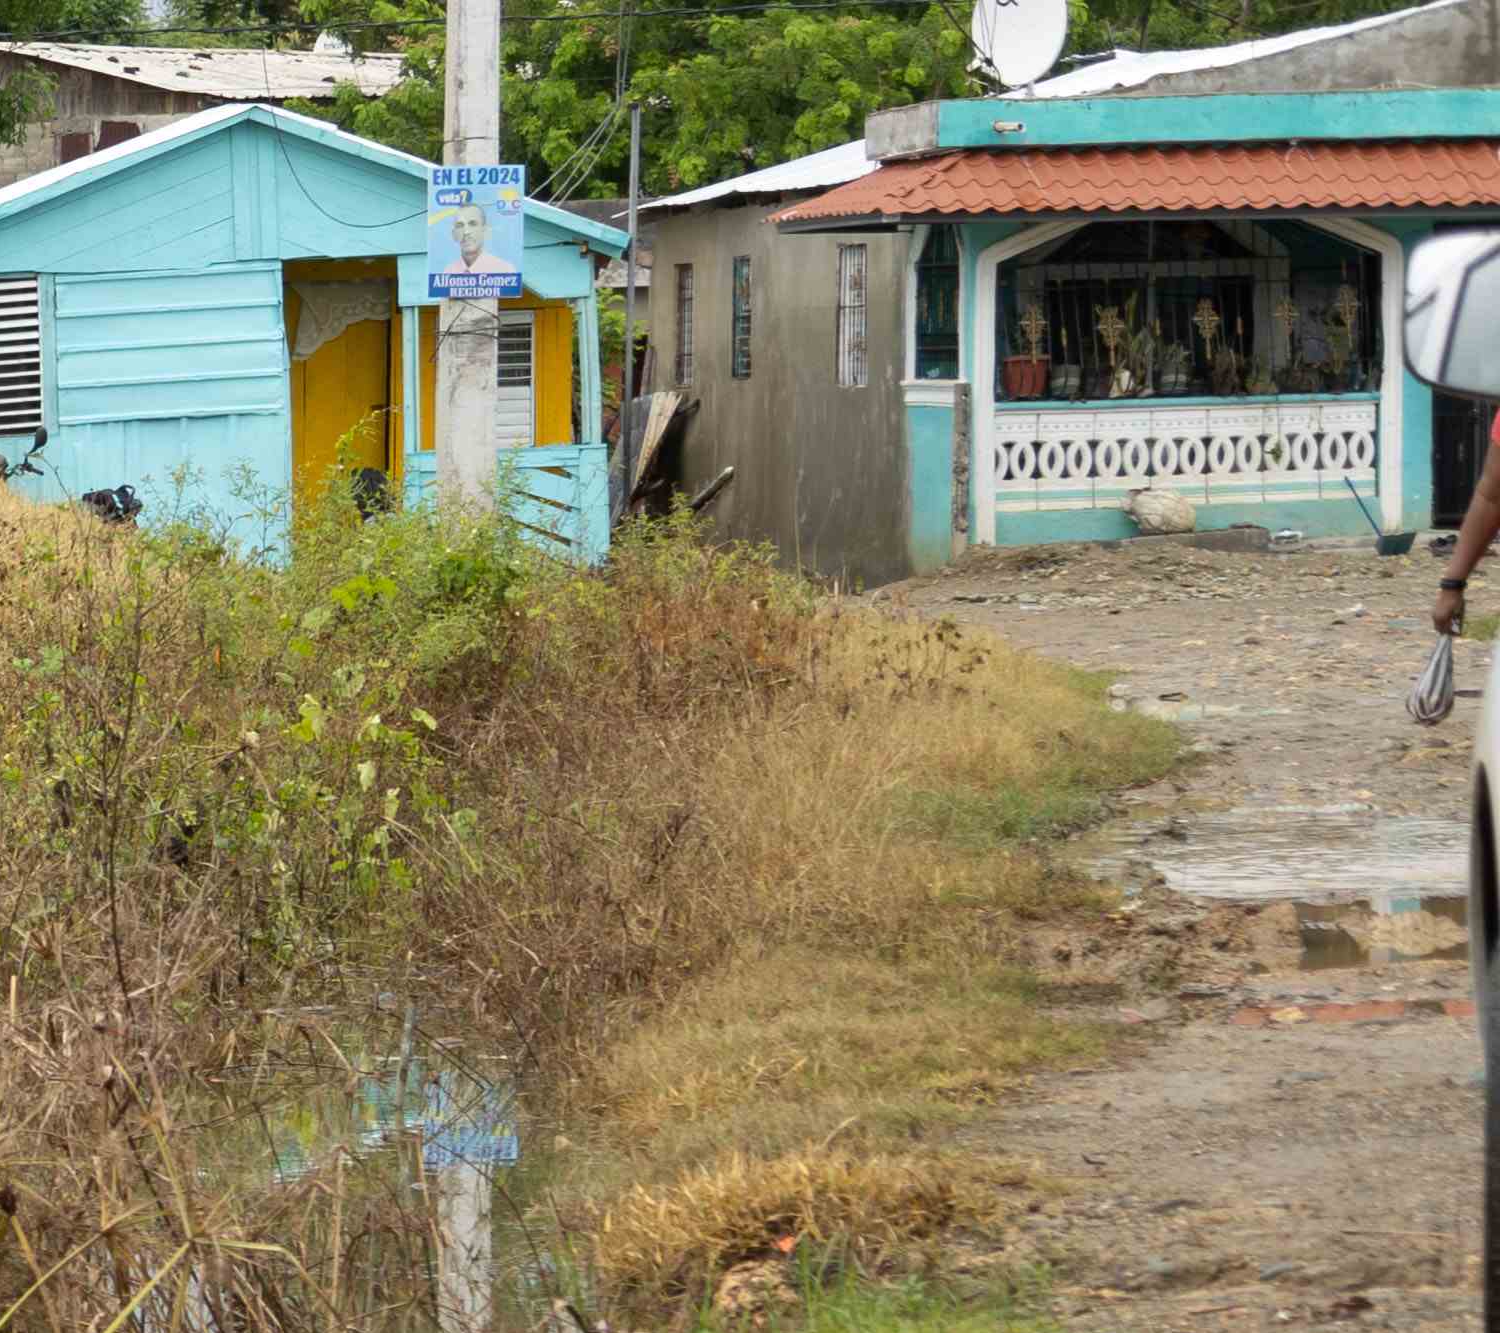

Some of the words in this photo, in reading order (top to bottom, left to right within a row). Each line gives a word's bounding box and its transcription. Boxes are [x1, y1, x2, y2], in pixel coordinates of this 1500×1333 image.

[433, 169, 452, 185] EN
[457, 168, 473, 184] EL
[477, 168, 520, 184] 2024
[433, 274, 476, 288] Alfonso
[449, 288, 500, 297] REGIDOR
